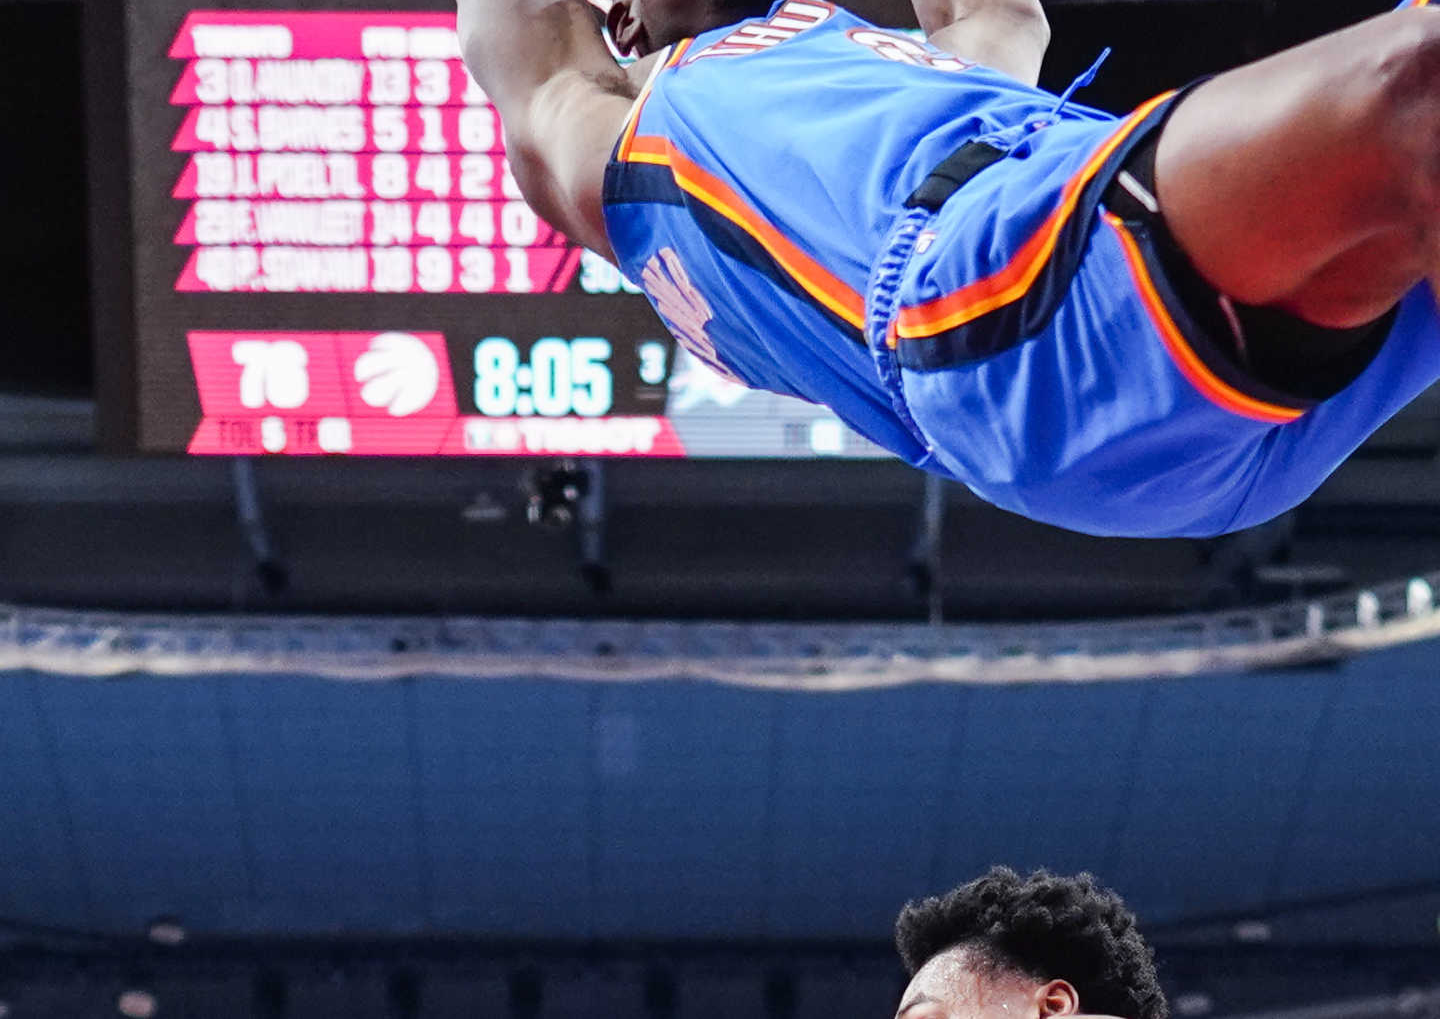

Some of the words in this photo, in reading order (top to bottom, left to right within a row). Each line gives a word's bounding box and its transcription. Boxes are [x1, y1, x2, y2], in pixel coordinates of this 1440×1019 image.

[415, 61, 448, 102] 3
[197, 107, 228, 149] 4
[373, 106, 407, 151] 5
[420, 108, 445, 150] 1
[459, 107, 493, 151] 6
[373, 154, 407, 197] 8
[417, 156, 449, 196] 4
[461, 155, 493, 197] 2
[417, 203, 450, 243] 4
[460, 203, 493, 243] 4
[502, 201, 537, 245] 0
[418, 248, 451, 291] 9
[460, 248, 493, 291] 3
[506, 249, 531, 291] 1
[473, 336, 613, 417] 8:05
[637, 342, 667, 385] 3
